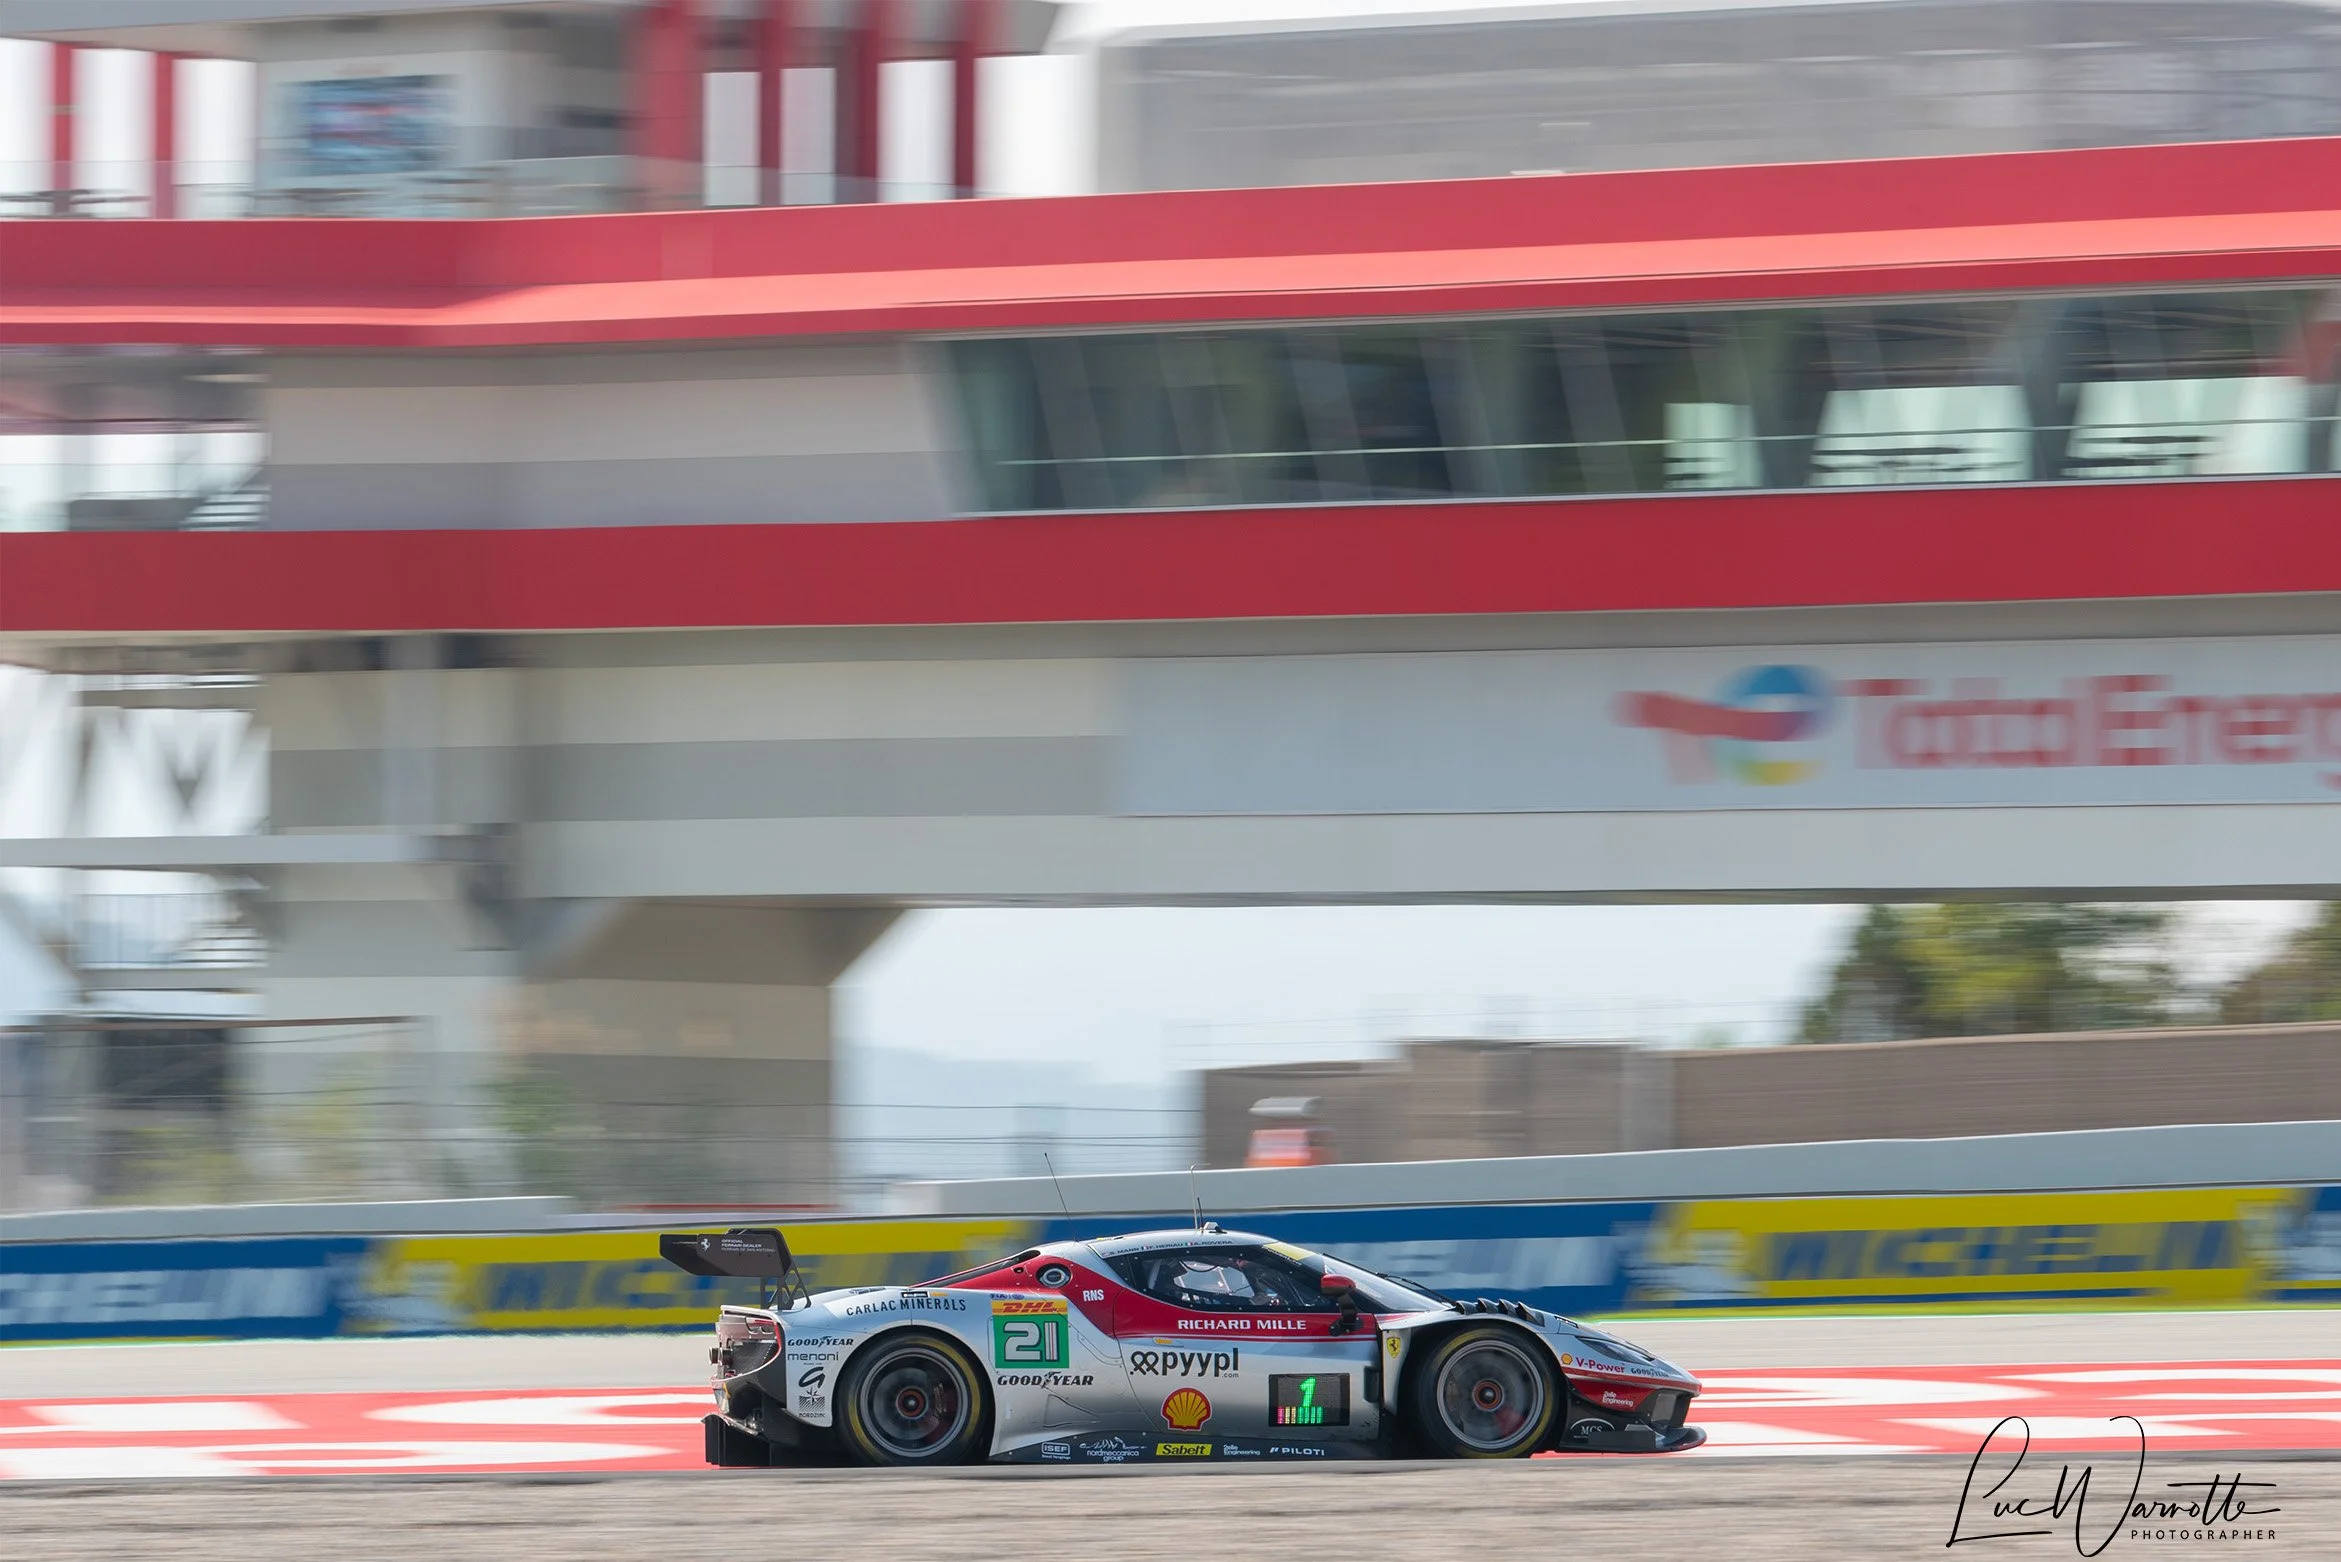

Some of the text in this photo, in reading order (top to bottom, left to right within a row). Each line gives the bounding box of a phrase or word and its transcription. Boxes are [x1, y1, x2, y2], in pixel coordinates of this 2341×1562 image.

[1083, 1289, 1104, 1302] RNS
[846, 1298, 966, 1316] CARLAC MINERALS
[1003, 1302, 1057, 1313] DHL
[1177, 1319, 1307, 1330] RICHARD MILLE
[1003, 1321, 1059, 1362] 21
[787, 1352, 839, 1361] menoni
[1162, 1347, 1239, 1378] pyypl
[1575, 1357, 1626, 1374] V-Power
[997, 1373, 1094, 1388] GOODYEAR
[1299, 1376, 1317, 1408] 1
[1044, 1444, 1068, 1453] ISEF
[1086, 1448, 1140, 1457] nordmeccanica
[1161, 1444, 1206, 1456] Sabelt
[1281, 1447, 1325, 1456] PILOTI
